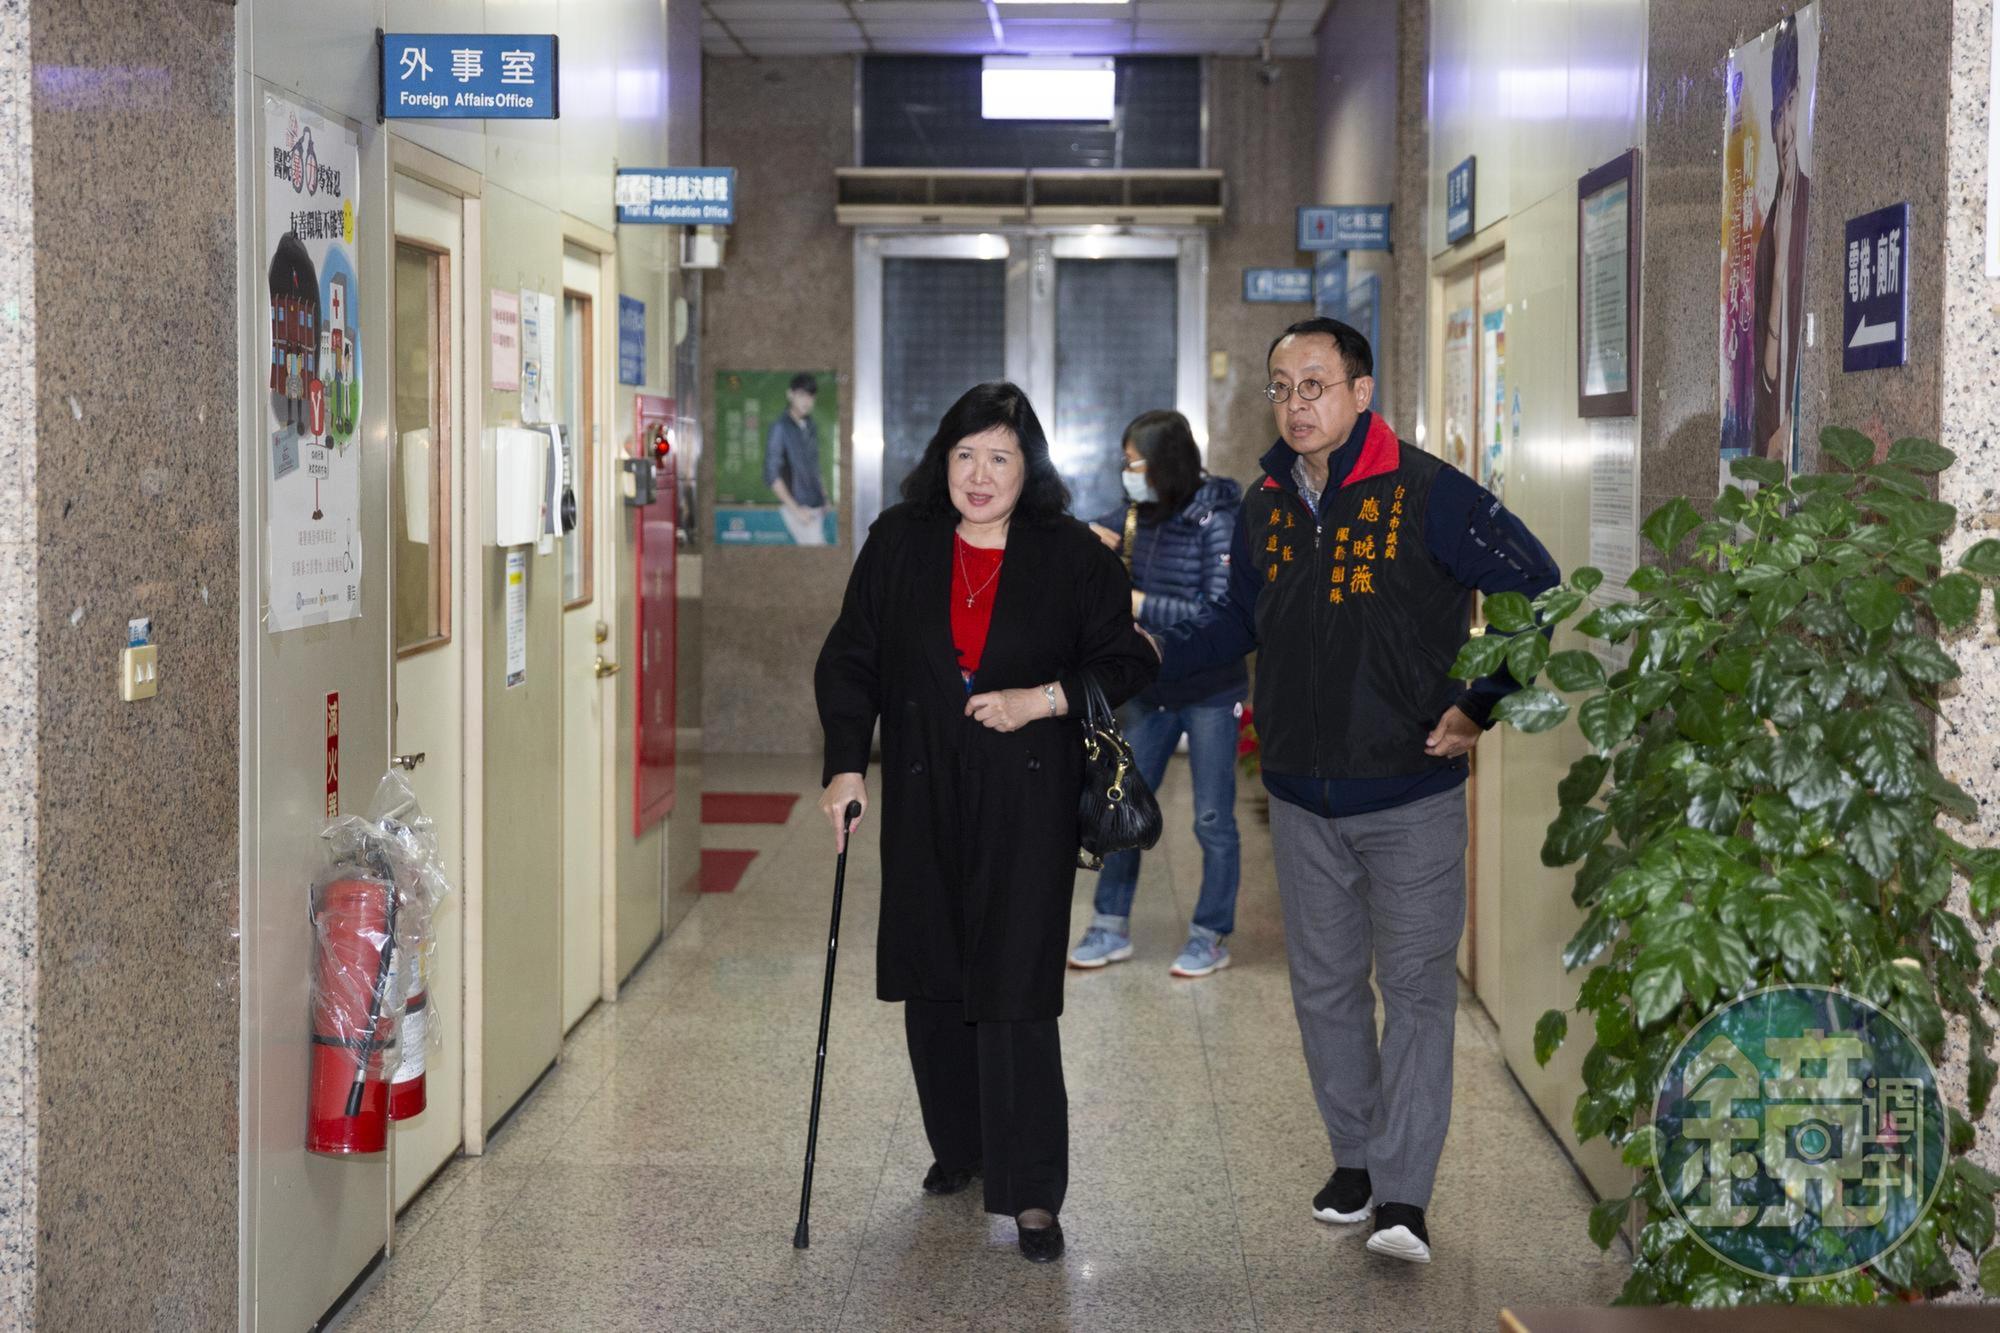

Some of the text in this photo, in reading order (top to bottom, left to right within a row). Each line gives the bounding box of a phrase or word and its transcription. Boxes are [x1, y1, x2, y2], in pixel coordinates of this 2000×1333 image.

[400, 47, 535, 84] 外事室
[400, 91, 534, 109] Foreign Affairs Office
[290, 209, 345, 241] 友善環境不能等
[1350, 497, 1381, 594] 應曉薇
[1384, 485, 1406, 561] 台北市議員
[1330, 527, 1349, 604] 服務團隊
[327, 700, 338, 818] 滅火器
